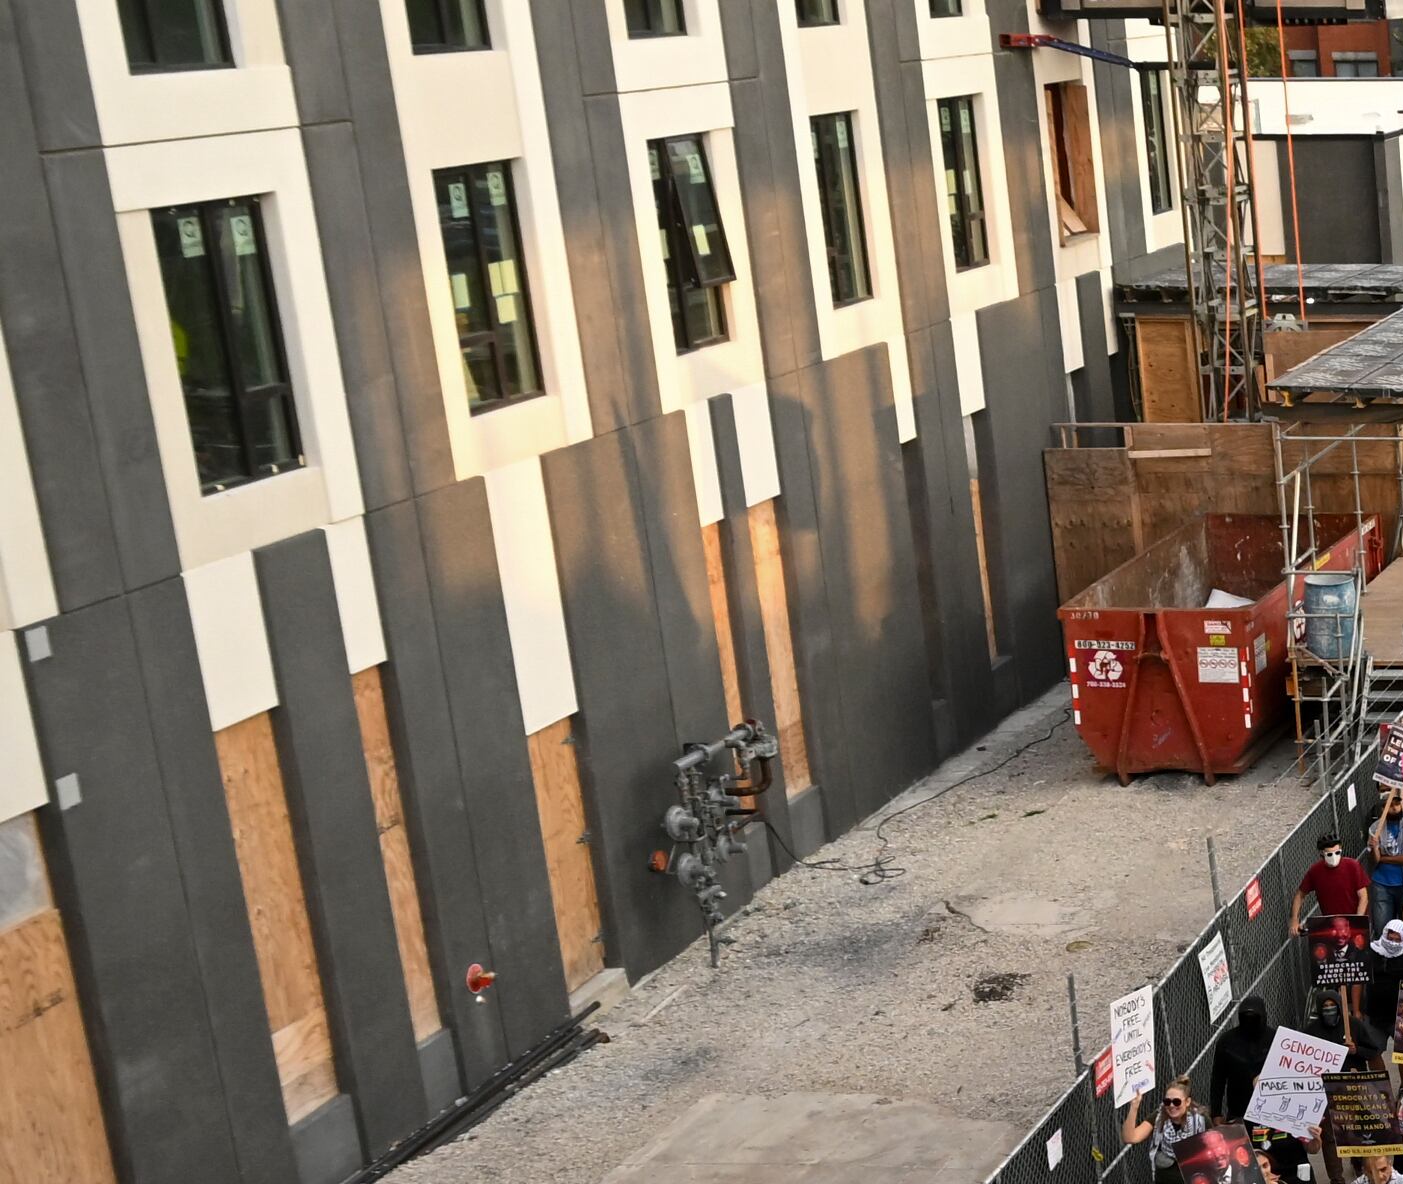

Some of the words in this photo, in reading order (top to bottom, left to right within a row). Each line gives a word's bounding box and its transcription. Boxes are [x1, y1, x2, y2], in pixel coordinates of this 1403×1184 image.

[1281, 1038, 1342, 1065] GENOCIDE
[1261, 1079, 1289, 1092] MADE
[1292, 1080, 1304, 1091] IN
